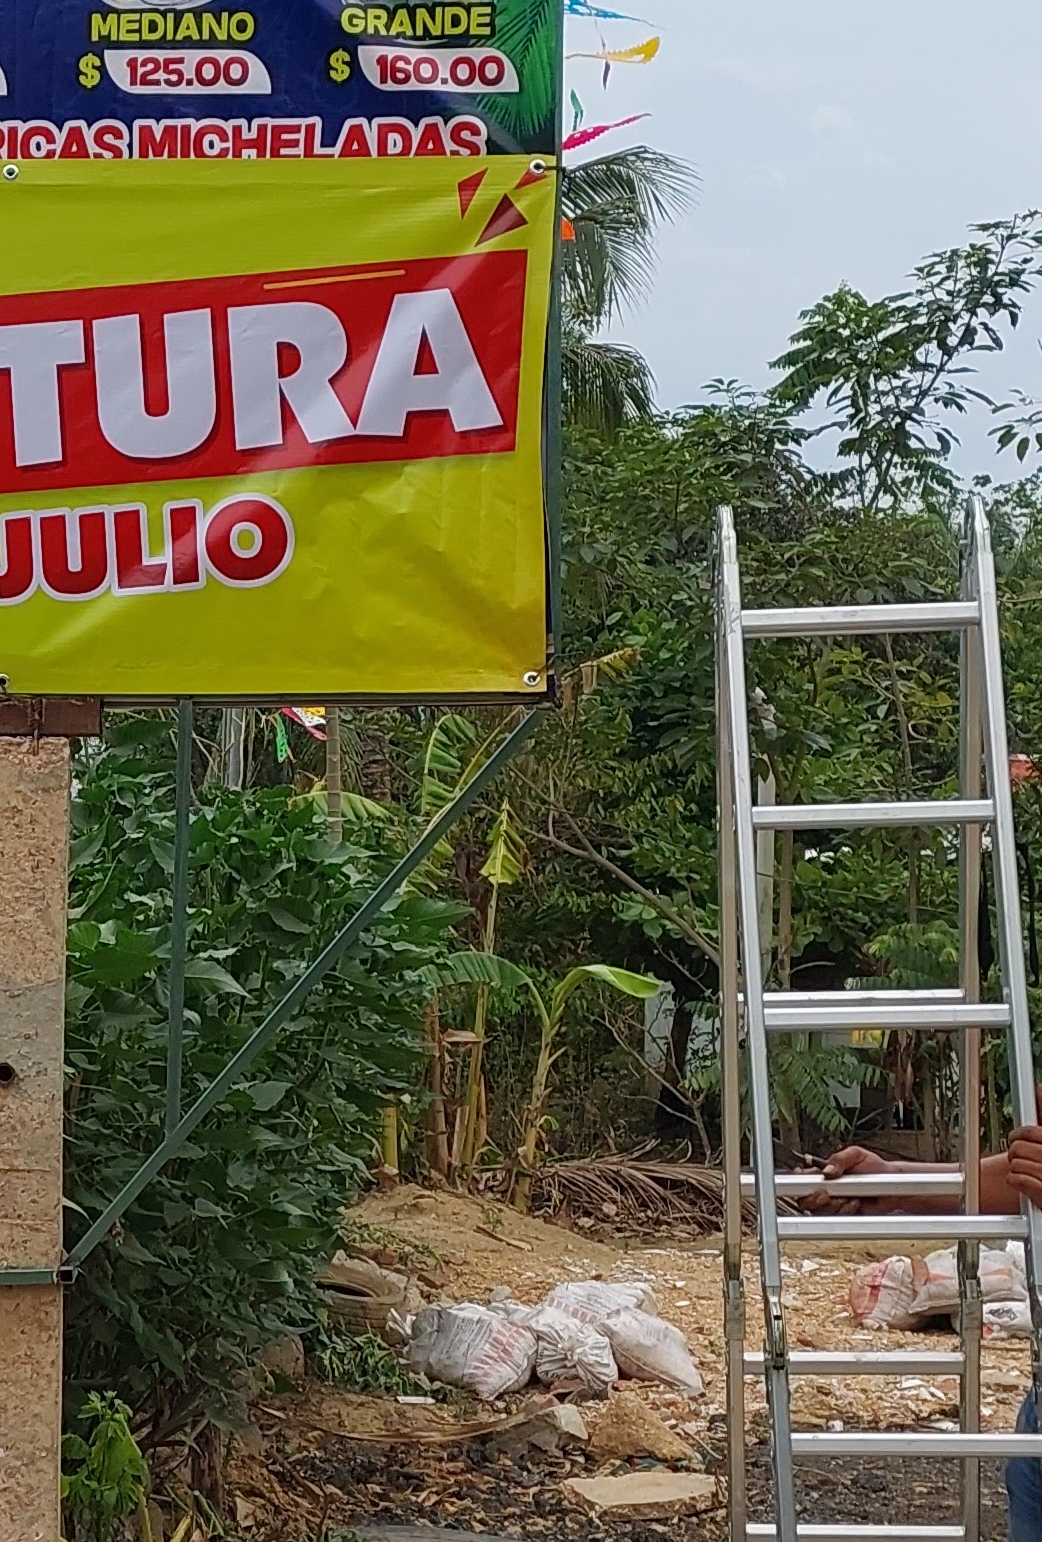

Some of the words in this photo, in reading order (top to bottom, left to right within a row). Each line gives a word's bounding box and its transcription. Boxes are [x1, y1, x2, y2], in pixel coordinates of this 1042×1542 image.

[90, 10, 256, 43] MEDIANO
[340, 5, 493, 37] GRANDE
[78, 53, 101, 89] $
[125, 56, 250, 87] 125.00
[328, 49, 351, 84] $
[376, 54, 506, 87] 160.00
[132, 115, 488, 159] MICHELADAS
